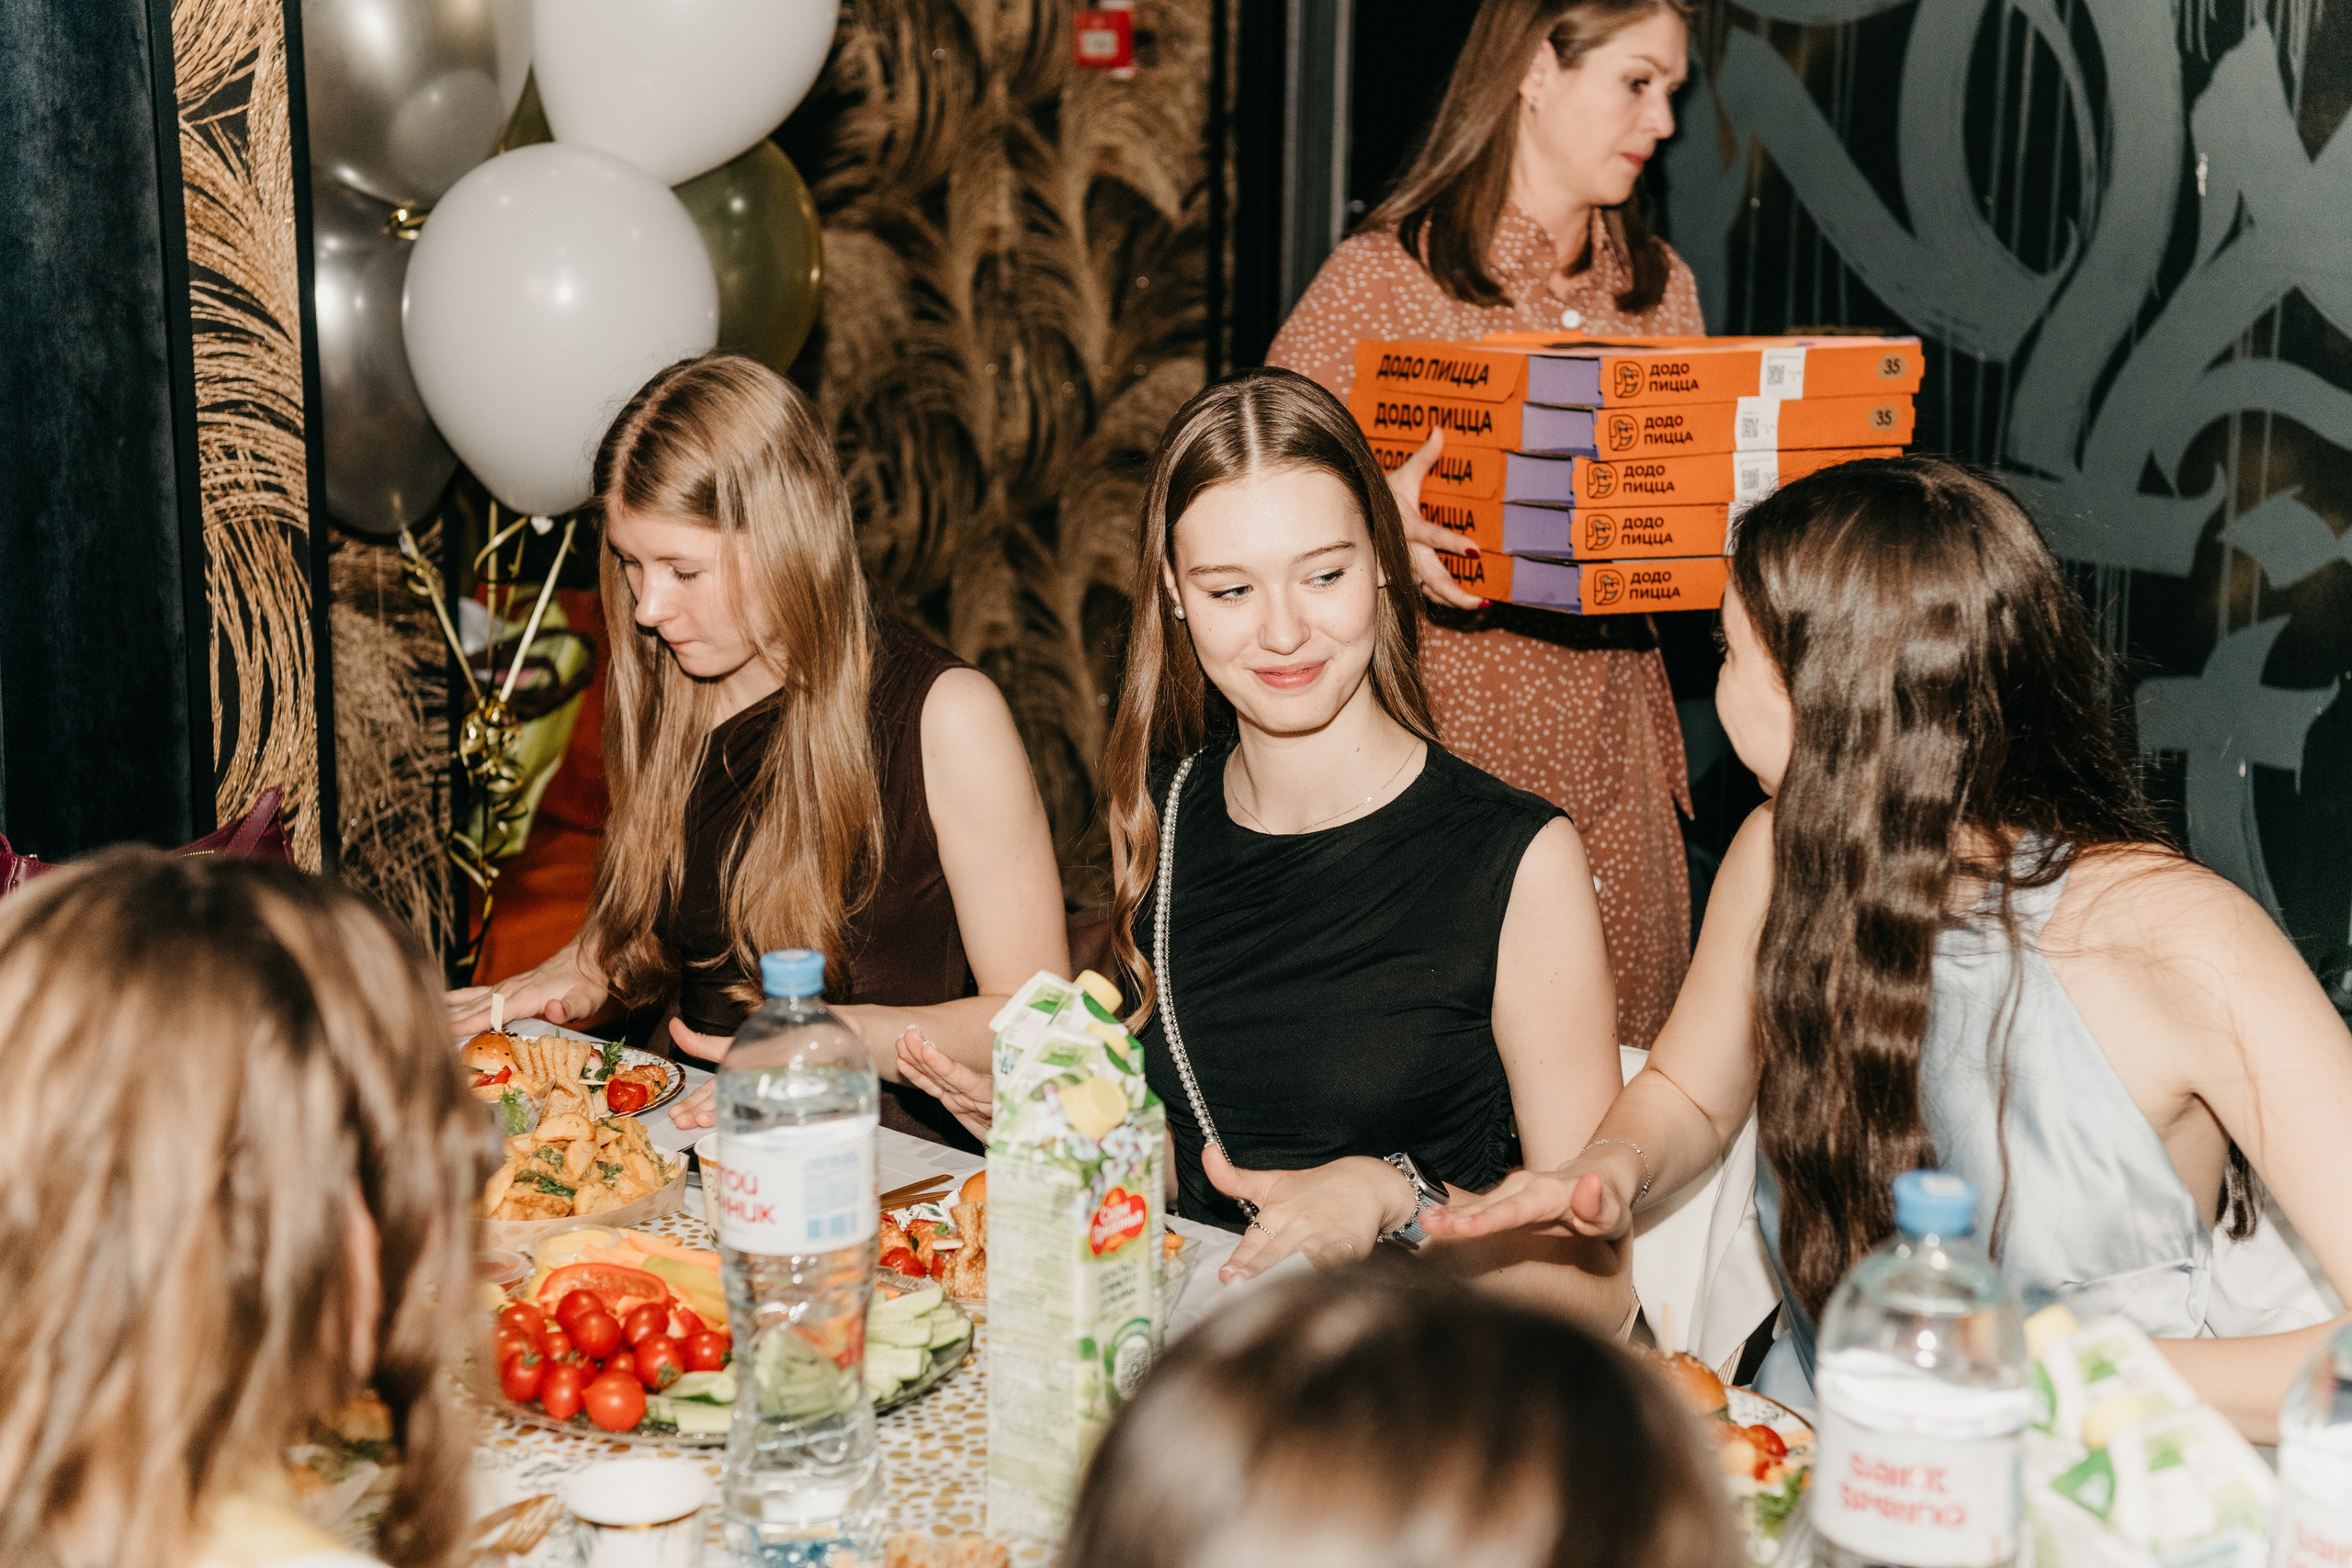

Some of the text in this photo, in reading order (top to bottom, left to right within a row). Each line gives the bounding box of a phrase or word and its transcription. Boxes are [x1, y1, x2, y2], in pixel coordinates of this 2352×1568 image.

[1376, 355, 1489, 388] ДОДО ПИЦЦА
[1649, 363, 1690, 377] ДОДО
[1883, 358, 1901, 375] 35
[1649, 379, 1699, 393] ПИЦЦА
[1374, 402, 1492, 436] ДОДО ПИЦЦА
[1644, 415, 1683, 430] ДОДО
[1875, 410, 1893, 426] 35
[1644, 432, 1693, 445] ПИЦЦА
[1429, 457, 1473, 485] ИЦЦА
[1623, 465, 1665, 479] ДОДО
[1623, 481, 1675, 493] ПИЦЦА
[1623, 517, 1664, 530] ДОДО
[1621, 534, 1673, 546] ПИЦЦА
[1630, 571, 1672, 584] ДОДО
[1629, 587, 1681, 600] ПИЦЦА
